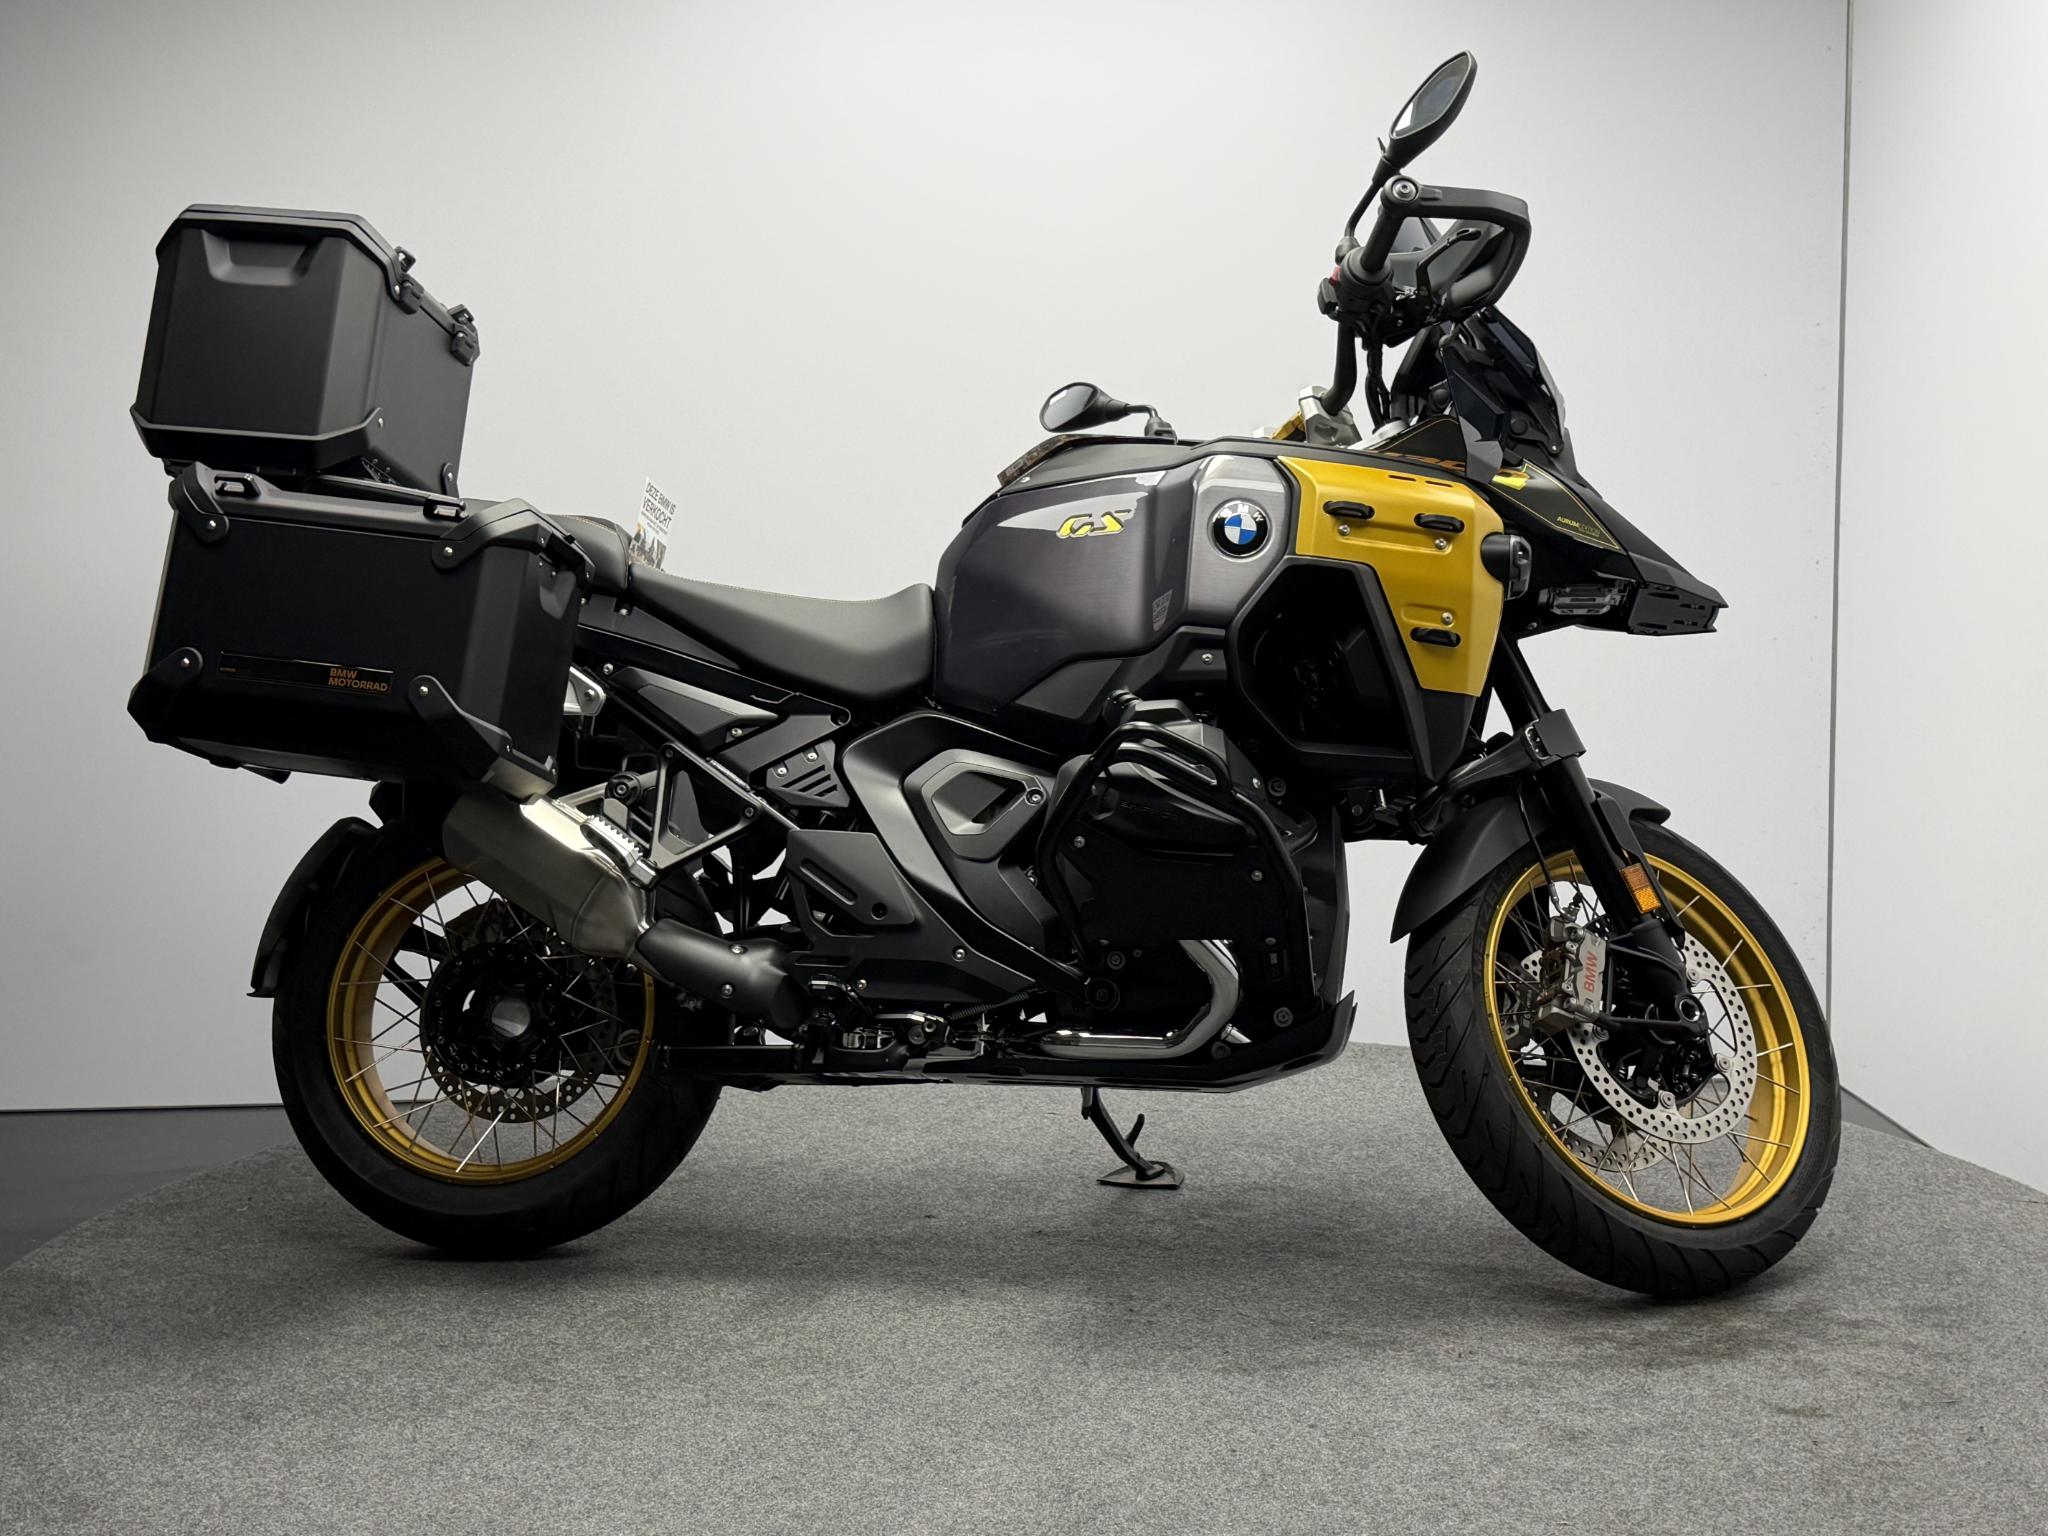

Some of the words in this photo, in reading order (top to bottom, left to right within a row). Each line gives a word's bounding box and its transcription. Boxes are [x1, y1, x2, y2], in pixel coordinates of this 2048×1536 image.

[1219, 503, 1264, 521] BMW
[1056, 508, 1134, 539] GS
[328, 667, 358, 679] BMW
[327, 676, 389, 692] MOTORRAD
[1583, 950, 1598, 994] BMW
